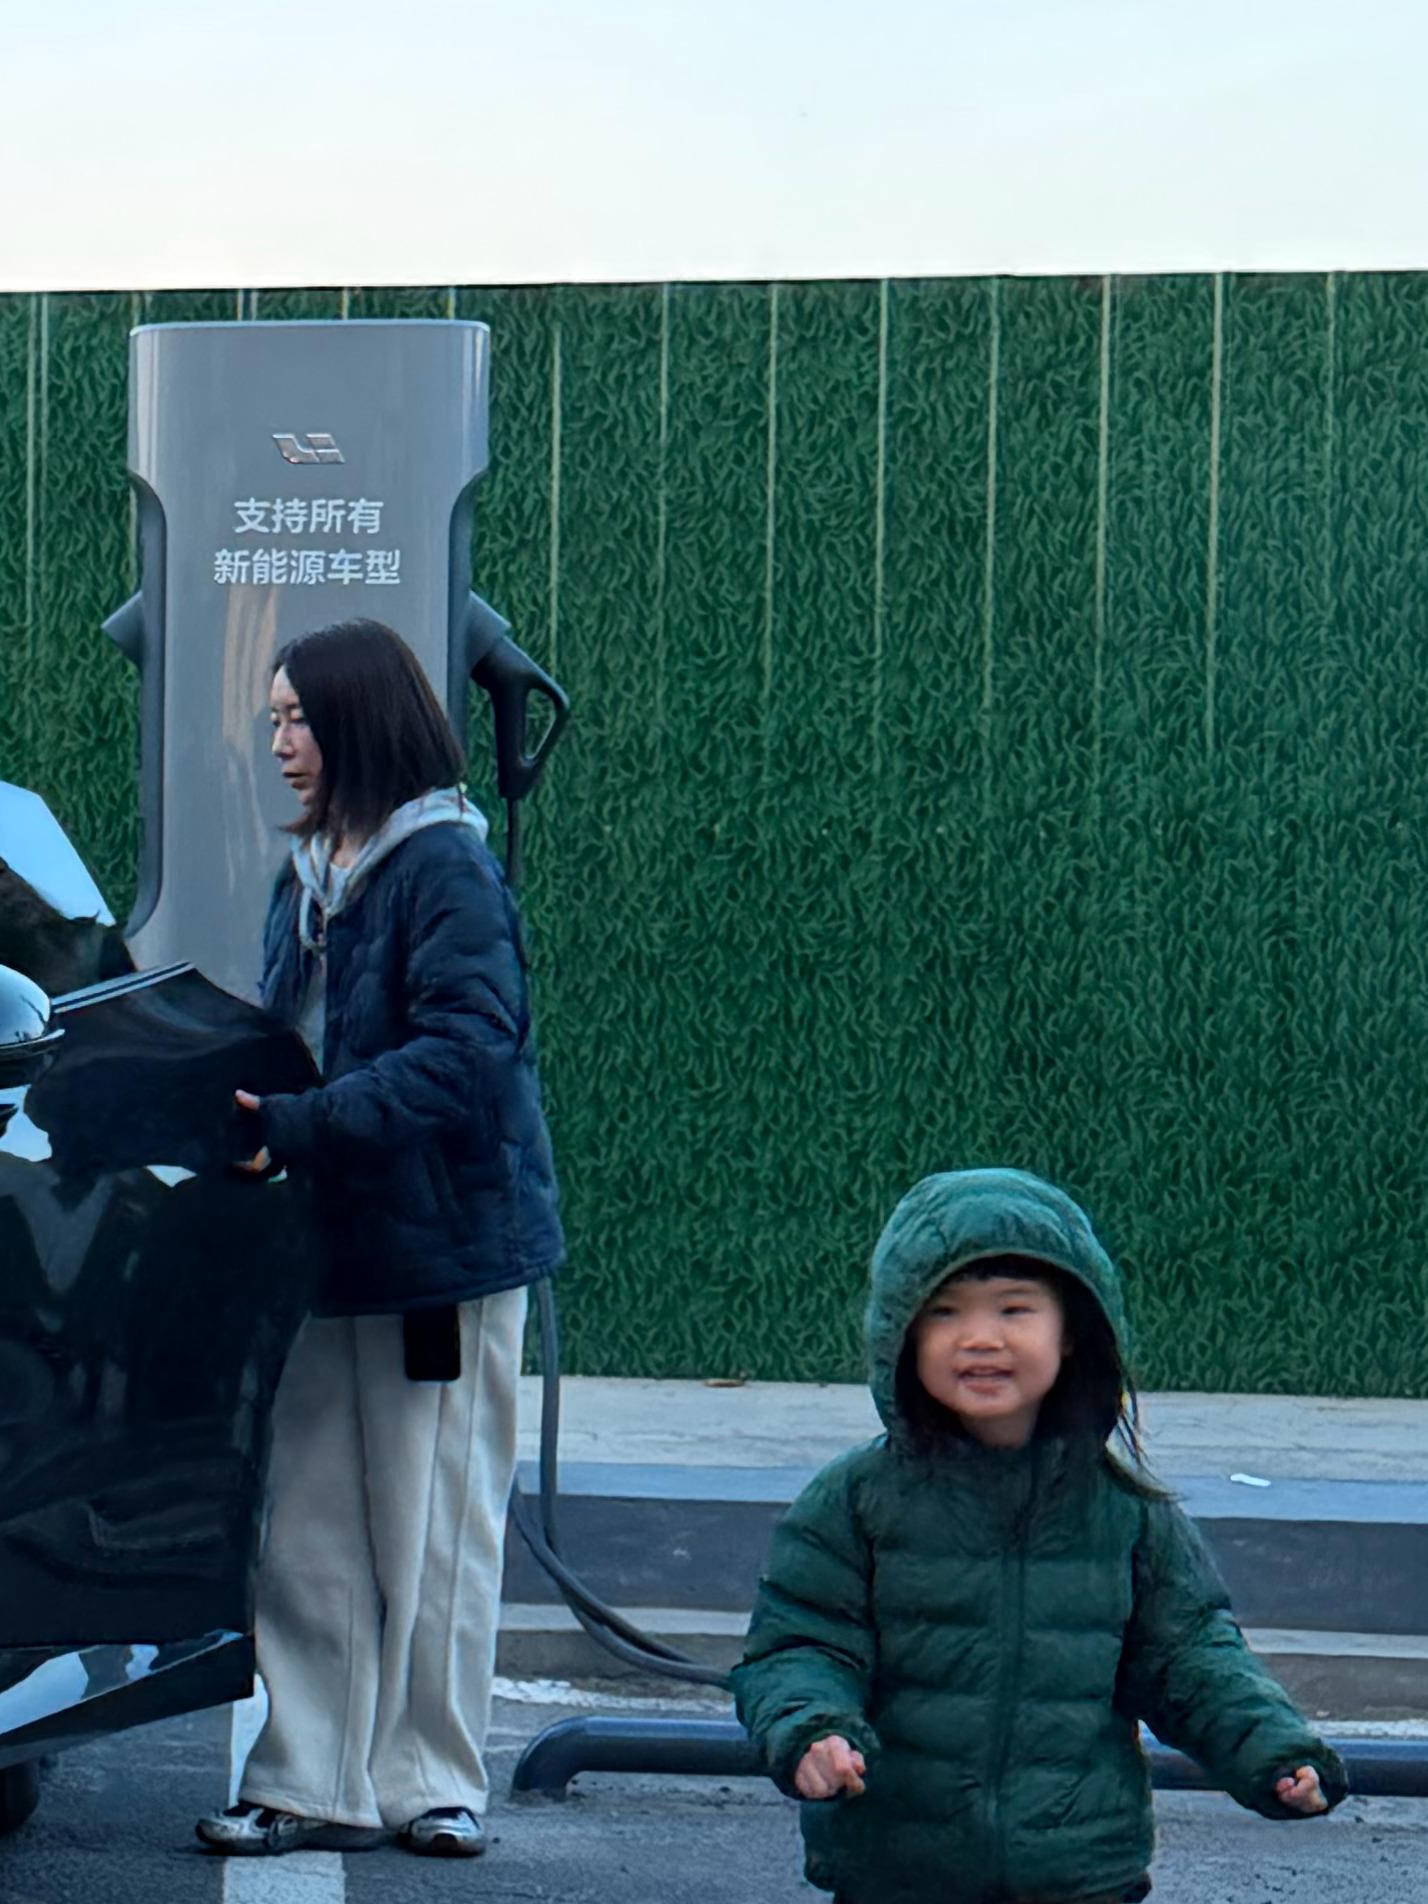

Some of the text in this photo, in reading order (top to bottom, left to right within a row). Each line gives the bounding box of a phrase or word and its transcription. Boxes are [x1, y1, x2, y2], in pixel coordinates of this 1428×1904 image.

[233, 497, 385, 535] 支持所有
[213, 548, 401, 586] 新能源车型
